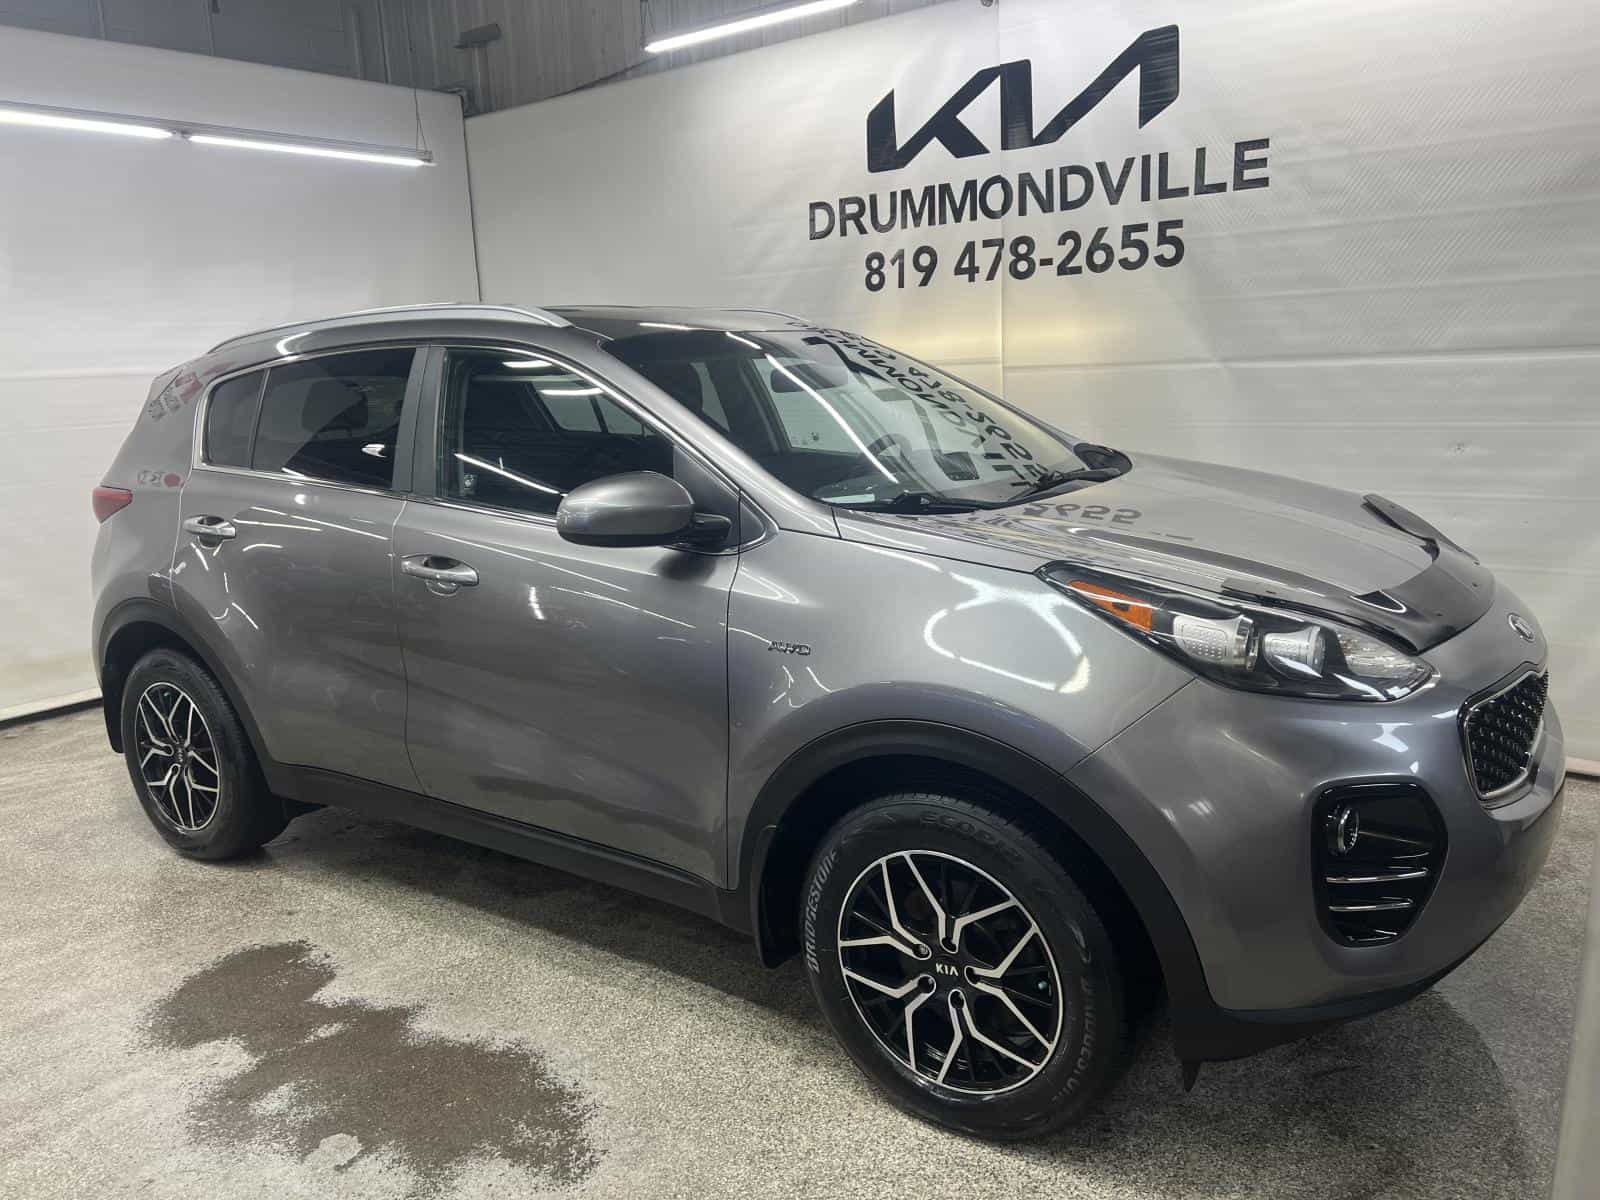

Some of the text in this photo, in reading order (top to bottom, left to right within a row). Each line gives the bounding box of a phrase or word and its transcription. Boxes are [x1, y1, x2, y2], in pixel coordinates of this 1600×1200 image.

[867, 24, 1180, 174] KIA
[808, 138, 1270, 241] DRUMMONDVILLE
[864, 219, 1185, 292] 819 478-2655
[767, 641, 812, 657] AWD
[803, 849, 837, 974] BRIDGESTONE
[934, 962, 959, 977] KIA
